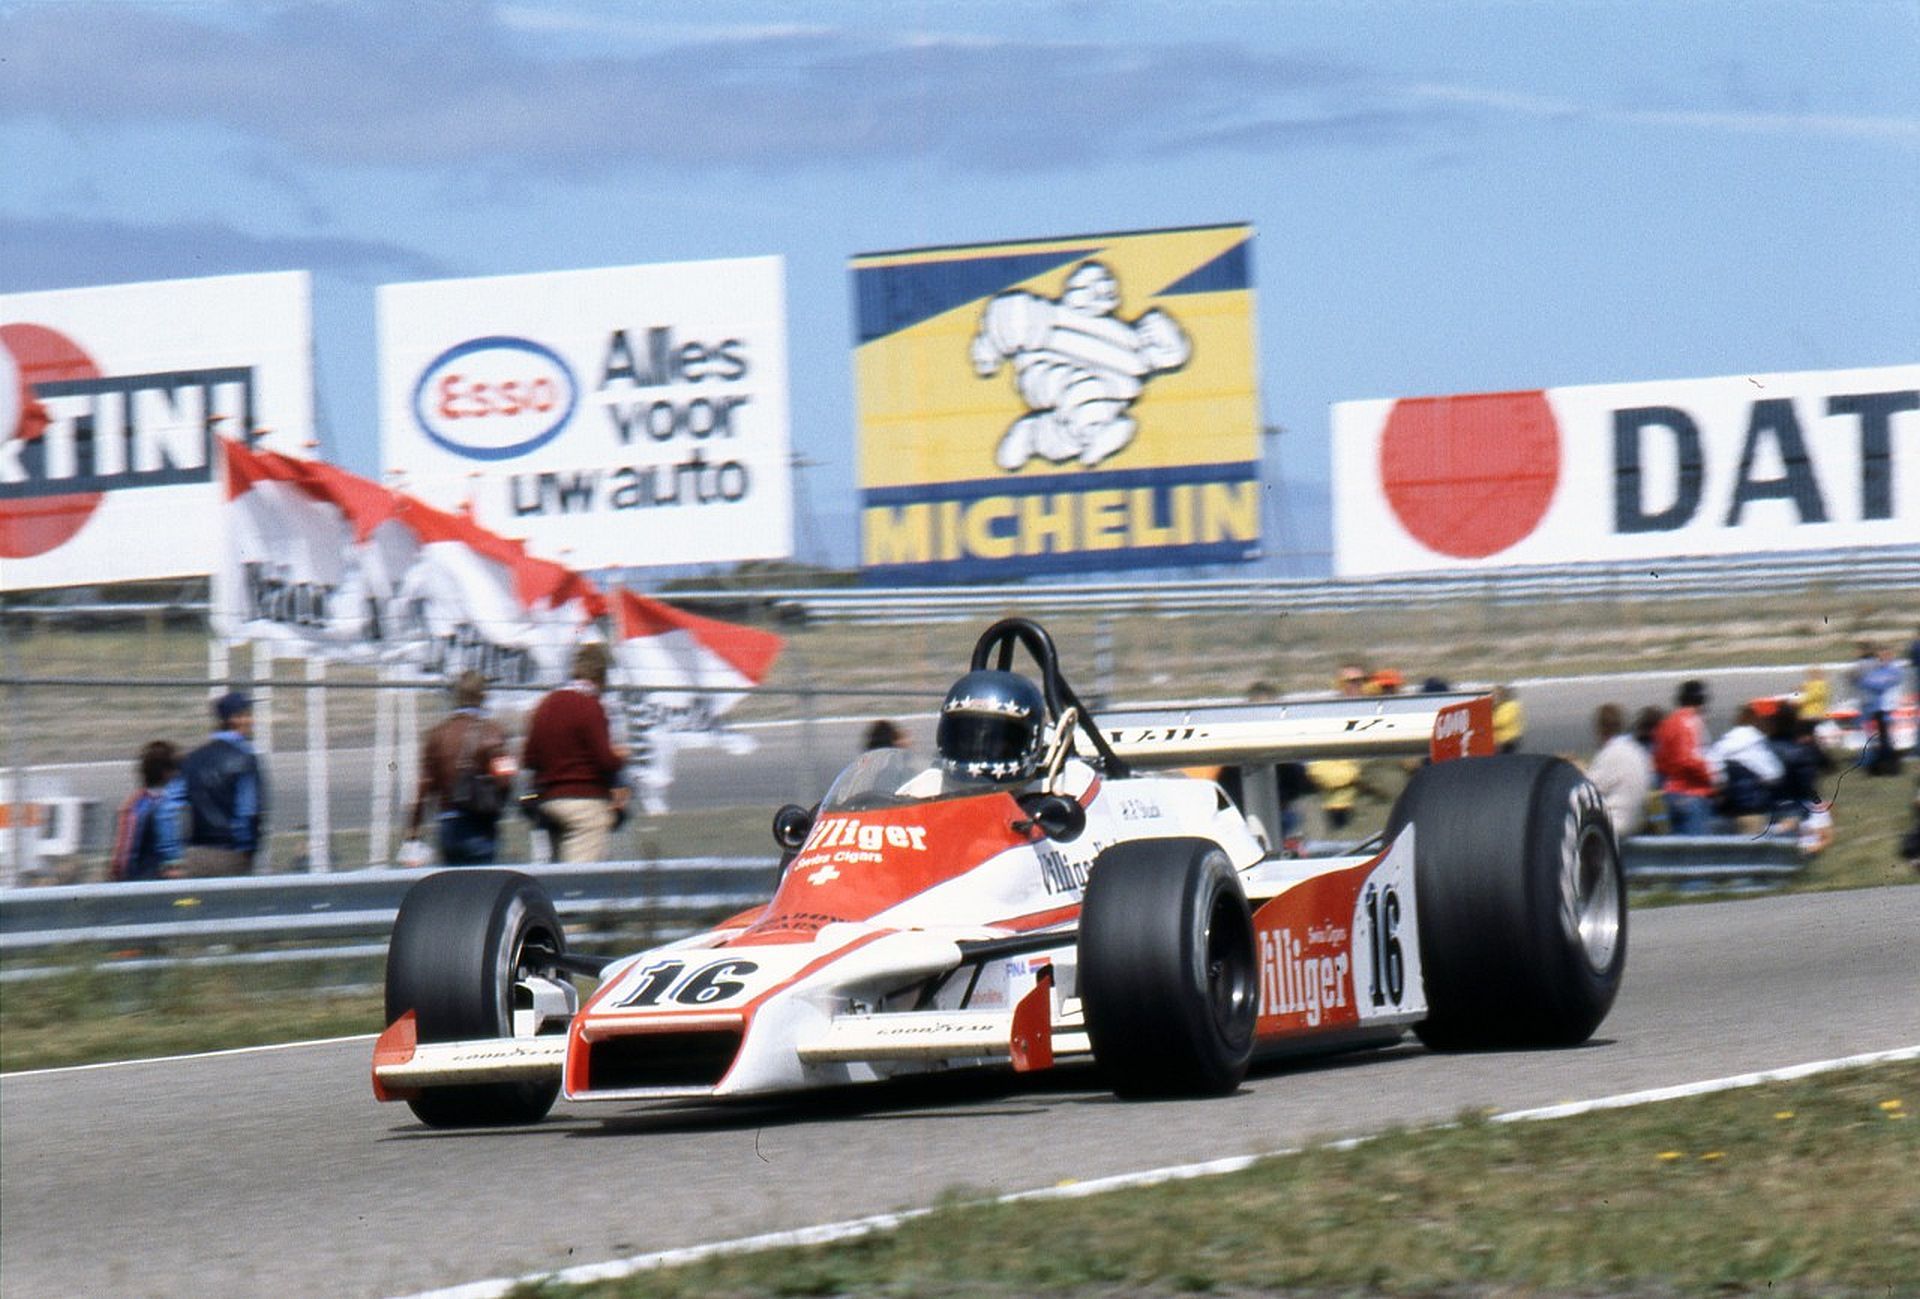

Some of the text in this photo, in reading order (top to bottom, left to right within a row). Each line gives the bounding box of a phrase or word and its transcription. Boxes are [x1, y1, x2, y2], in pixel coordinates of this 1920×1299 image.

[600, 326, 747, 390] Alles
[440, 374, 555, 420] Esso
[607, 395, 749, 443] voor
[611, 449, 748, 510] auto
[862, 480, 1260, 566] MICHELIN
[1366, 883, 1405, 1007] 16
[614, 958, 759, 1008] 16
